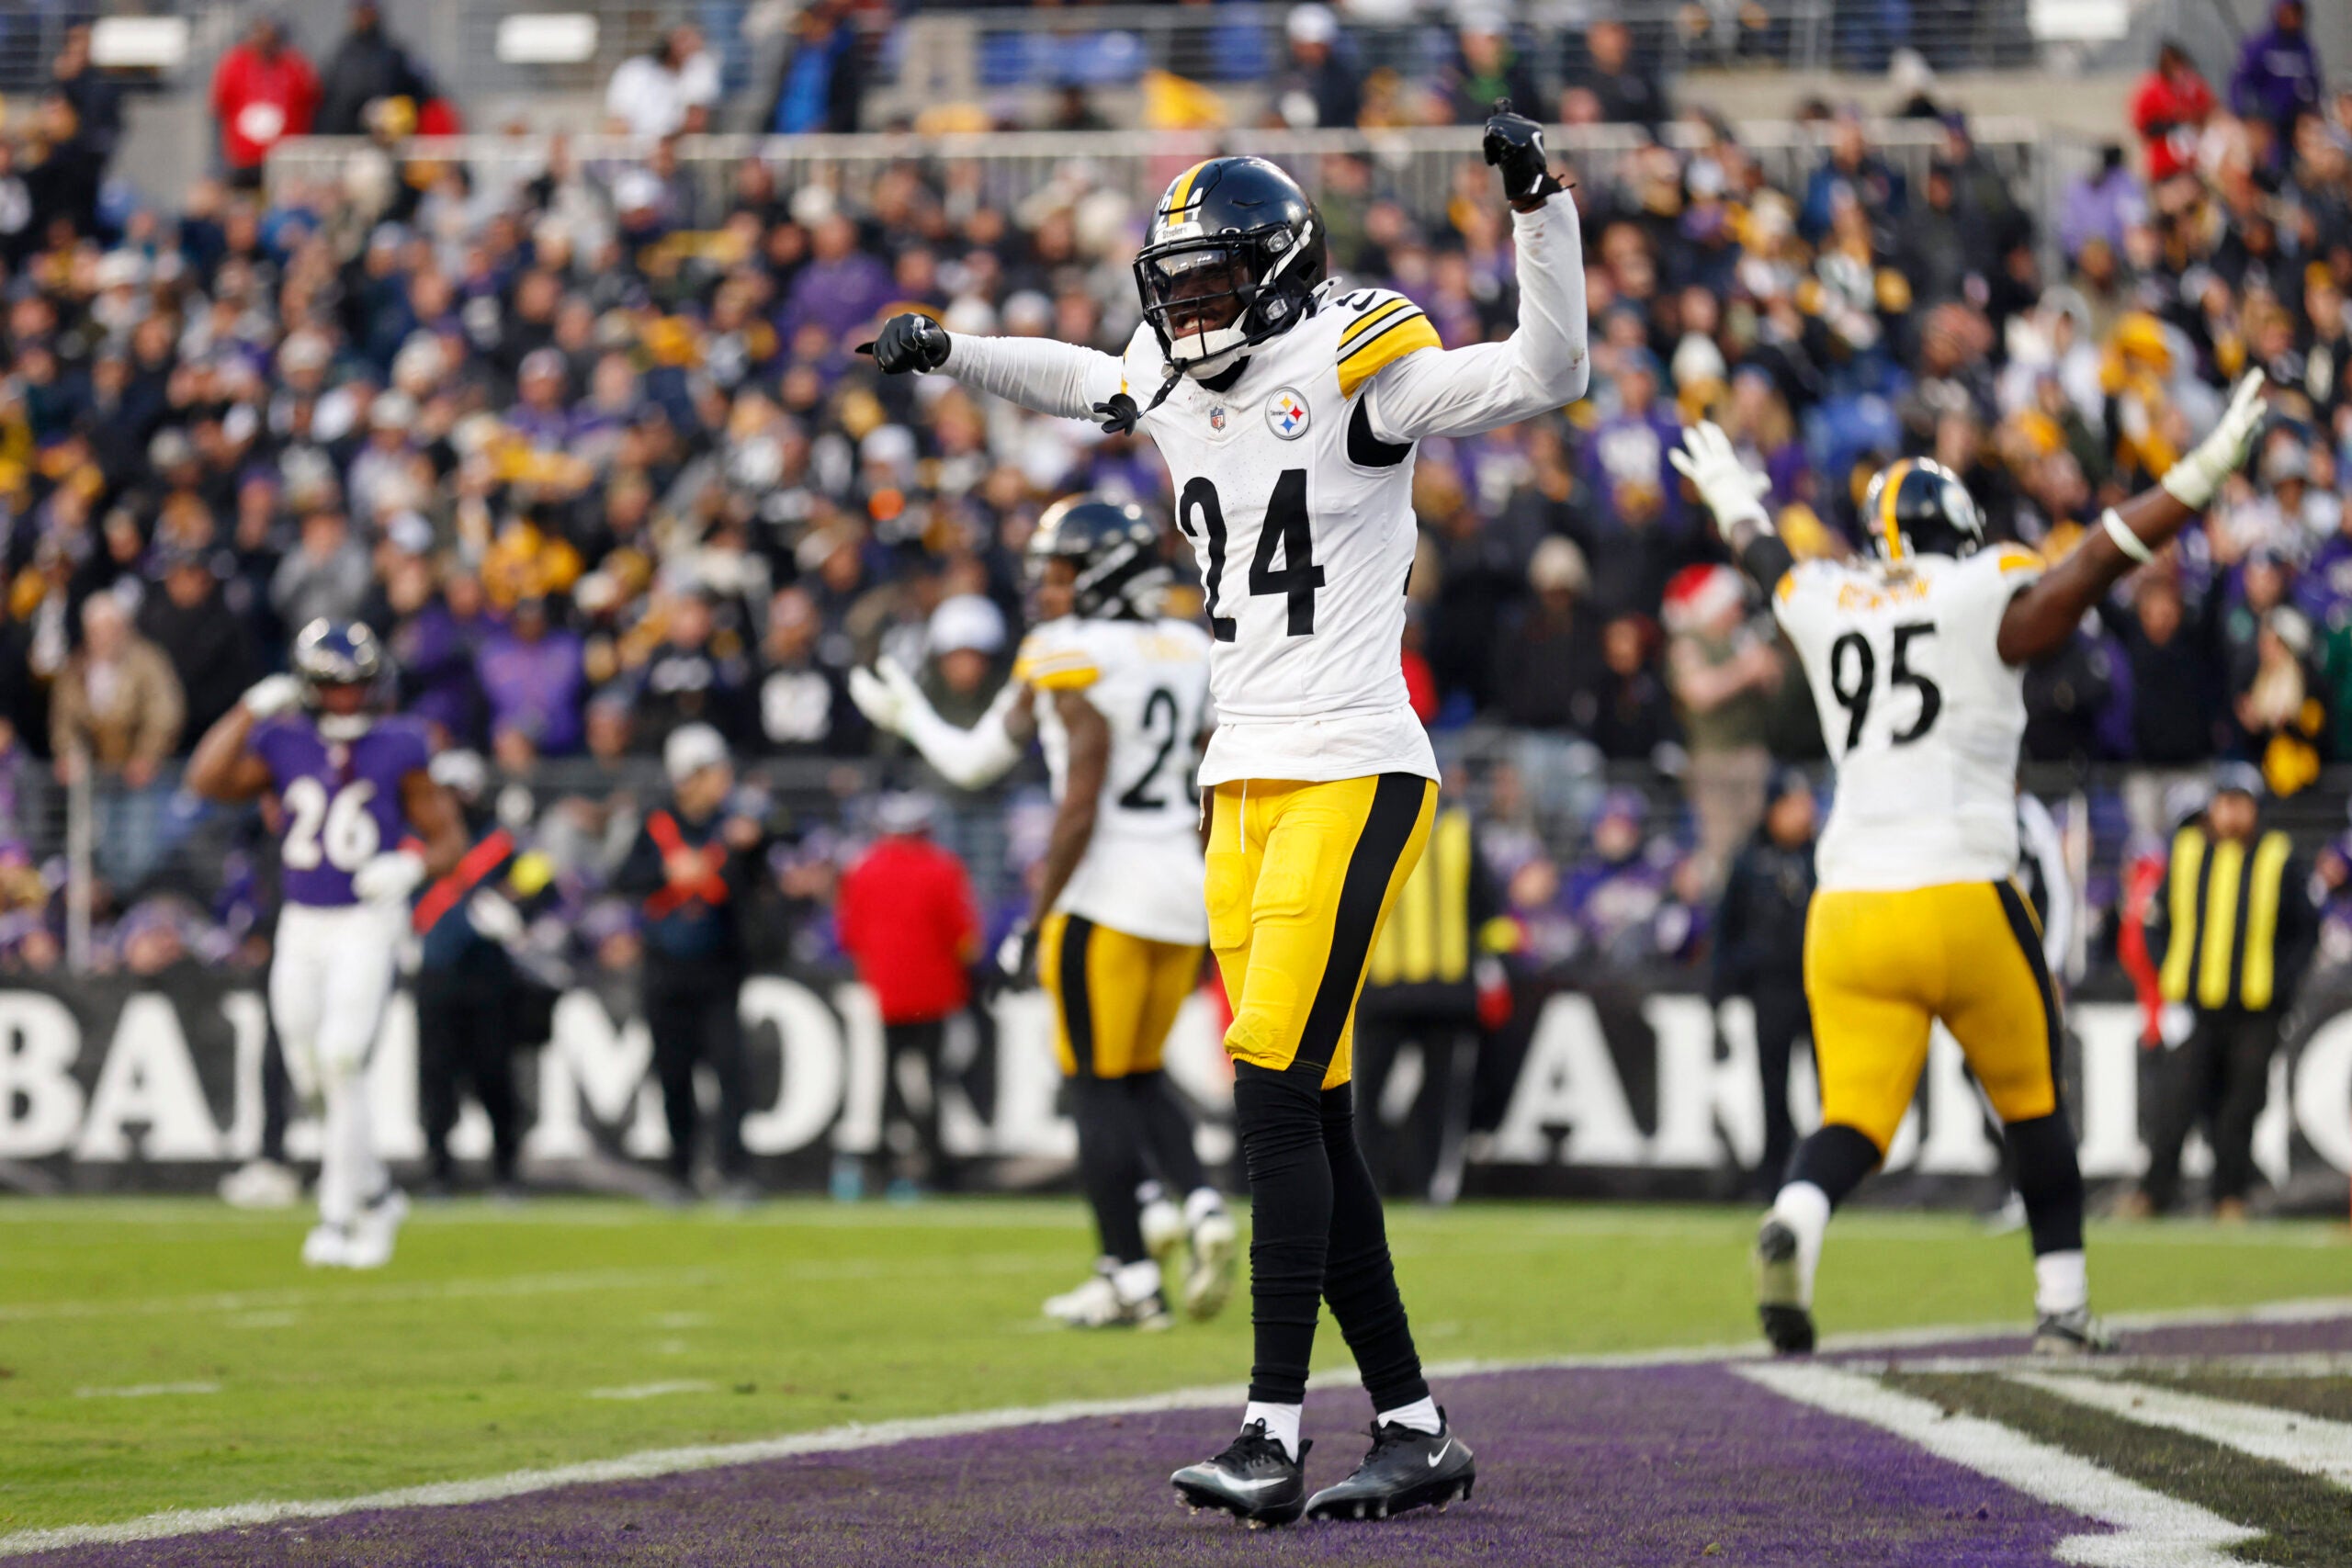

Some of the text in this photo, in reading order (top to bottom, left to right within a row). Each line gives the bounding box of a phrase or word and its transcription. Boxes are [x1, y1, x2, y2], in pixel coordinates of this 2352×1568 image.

[1155, 186, 1204, 231] 24
[1180, 468, 1326, 642] 24
[1831, 622, 1941, 751] 95
[281, 774, 380, 873] 26
